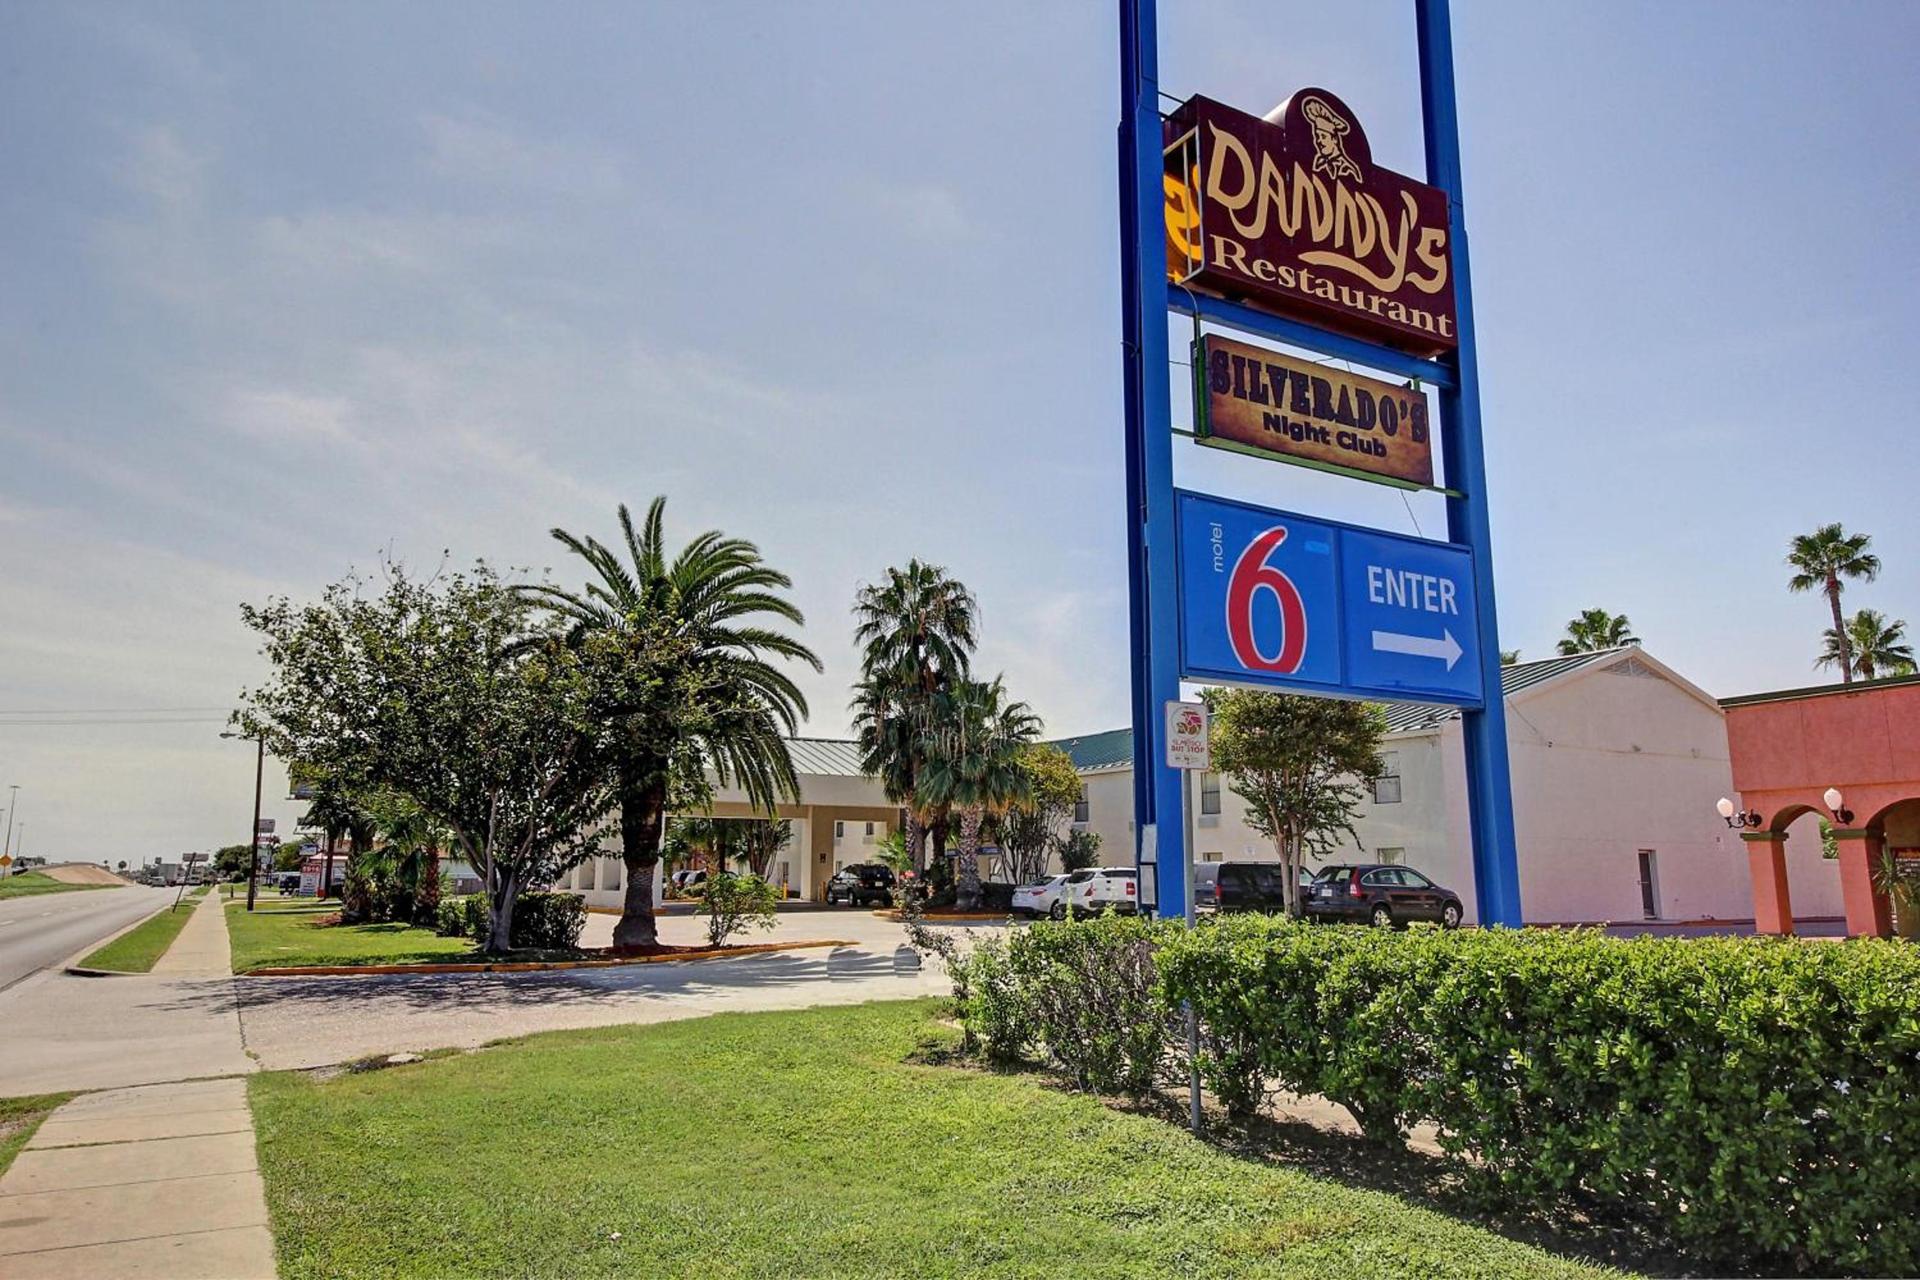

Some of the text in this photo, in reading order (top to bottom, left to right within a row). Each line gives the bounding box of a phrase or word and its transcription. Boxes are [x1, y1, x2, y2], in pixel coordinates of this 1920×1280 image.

[1209, 234, 1453, 338] Restaurant
[1210, 349, 1426, 443] SILVERADO'S
[1336, 430, 1387, 458] Club
[1210, 522, 1223, 573] motel
[1226, 525, 1307, 674] 6
[1367, 565, 1459, 615] ENTER
